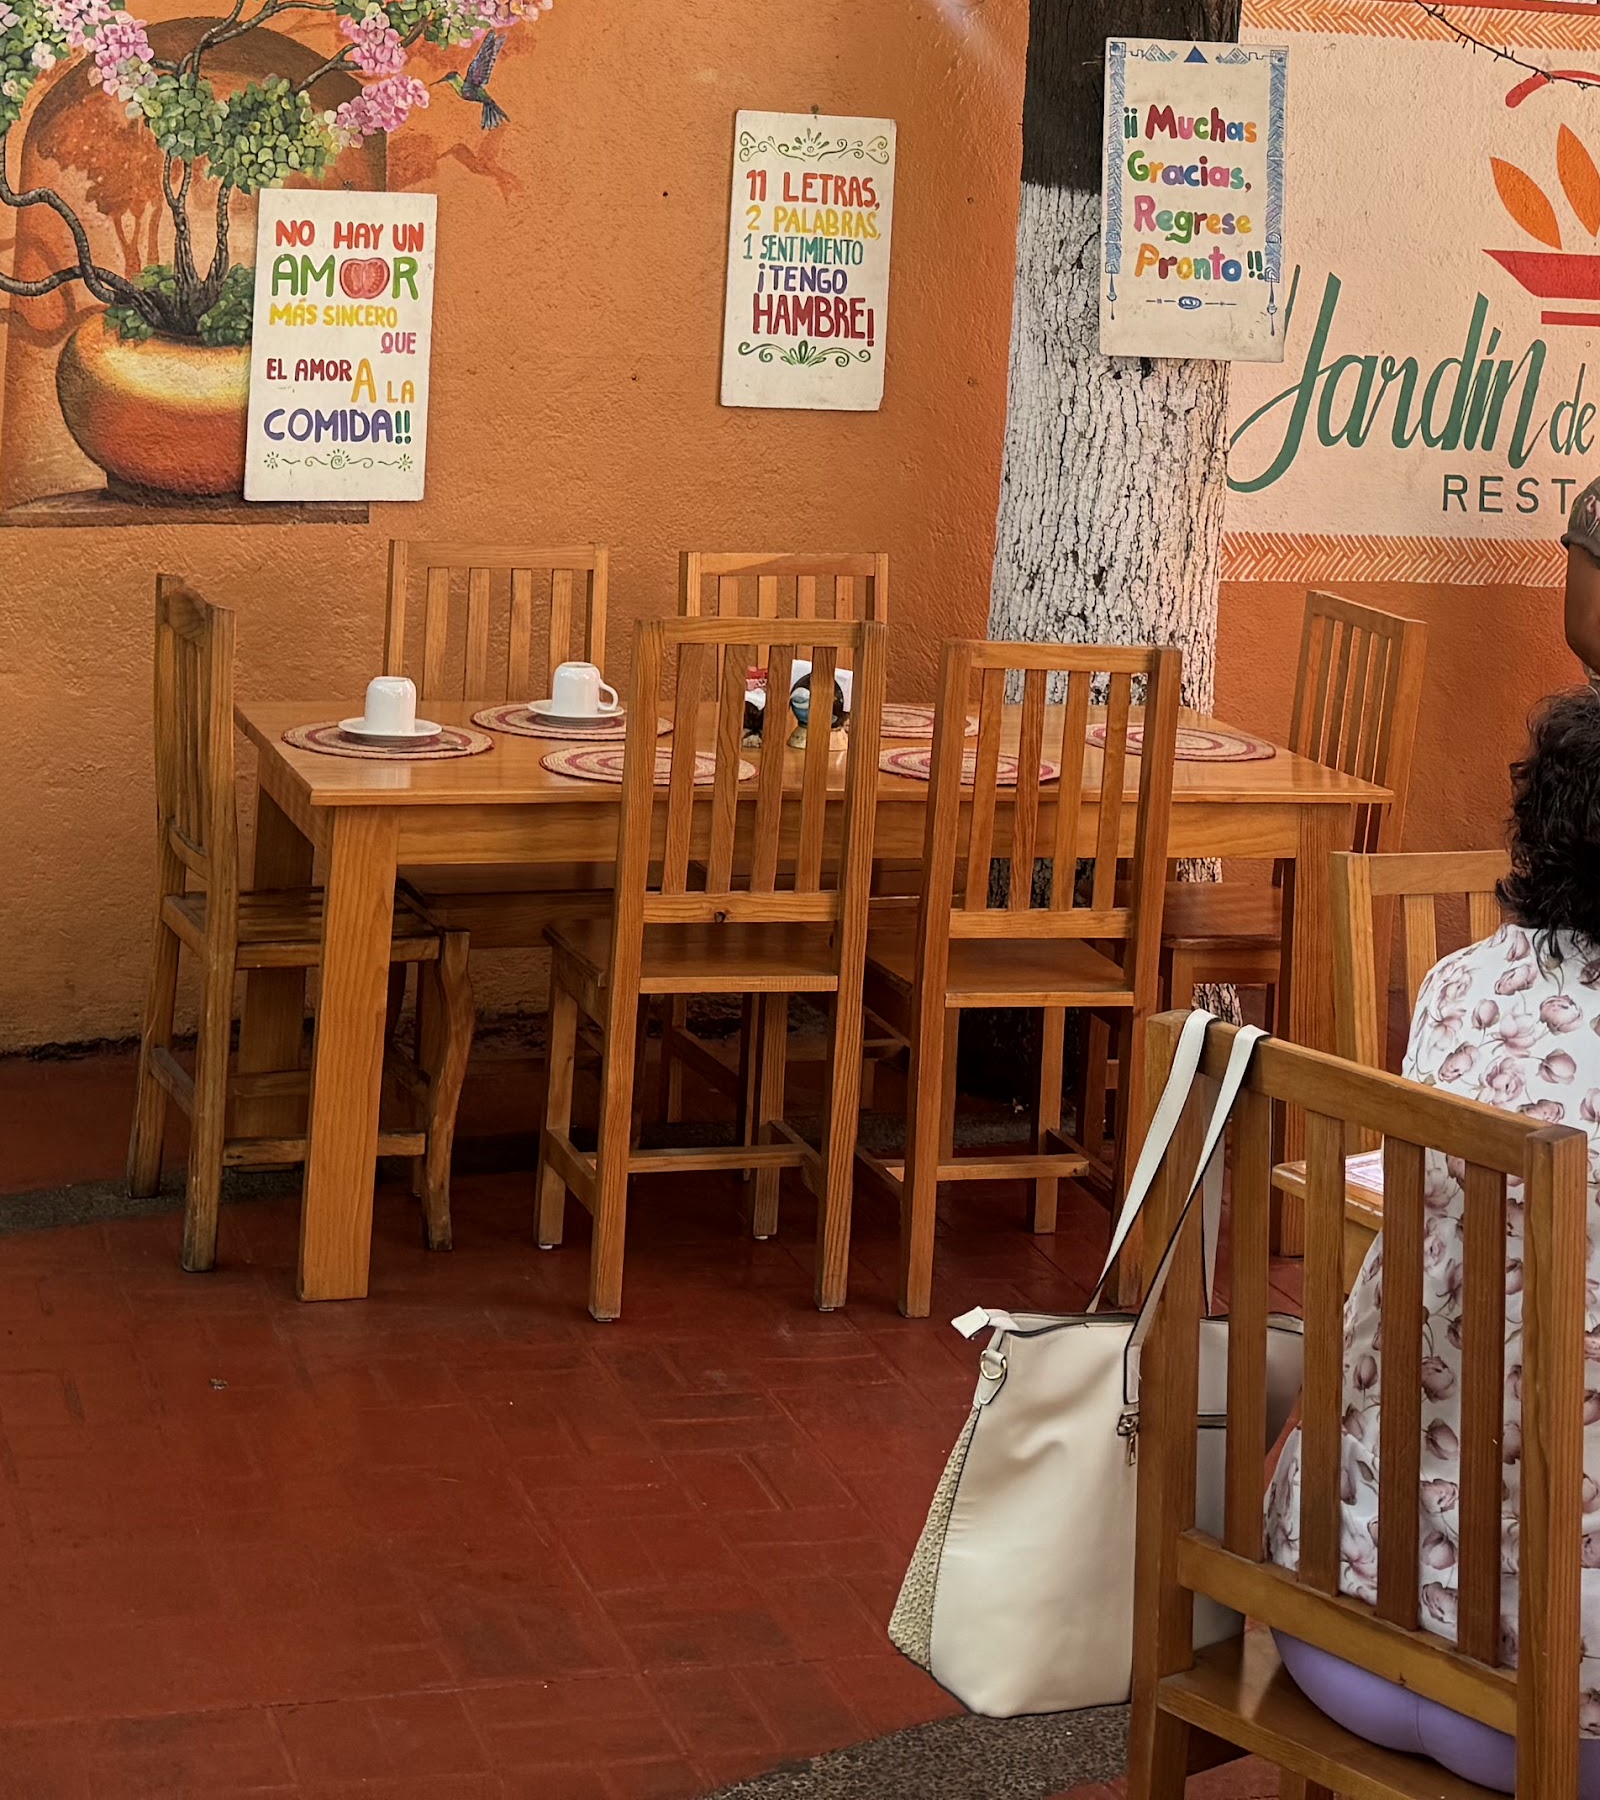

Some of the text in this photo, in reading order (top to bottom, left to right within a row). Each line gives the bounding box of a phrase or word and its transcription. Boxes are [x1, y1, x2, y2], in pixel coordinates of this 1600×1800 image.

[746, 169, 880, 210] 11 LETRAS,
[1127, 150, 1252, 193] Gracias,
[275, 219, 425, 253] NO HAY UN
[745, 204, 881, 241] 2 PALABRAS,
[1133, 195, 1253, 244] Regrese
[743, 233, 864, 266] 1 SENTIMIENTO
[757, 263, 848, 295] ¡TENGO
[323, 304, 398, 329] SINCERO
[752, 293, 875, 347] HAMBRE!
[380, 331, 417, 355] QUE
[266, 358, 415, 404] EL AMOR A LA
[263, 408, 412, 445] COMIDA!!
[1550, 362, 1597, 456] de
